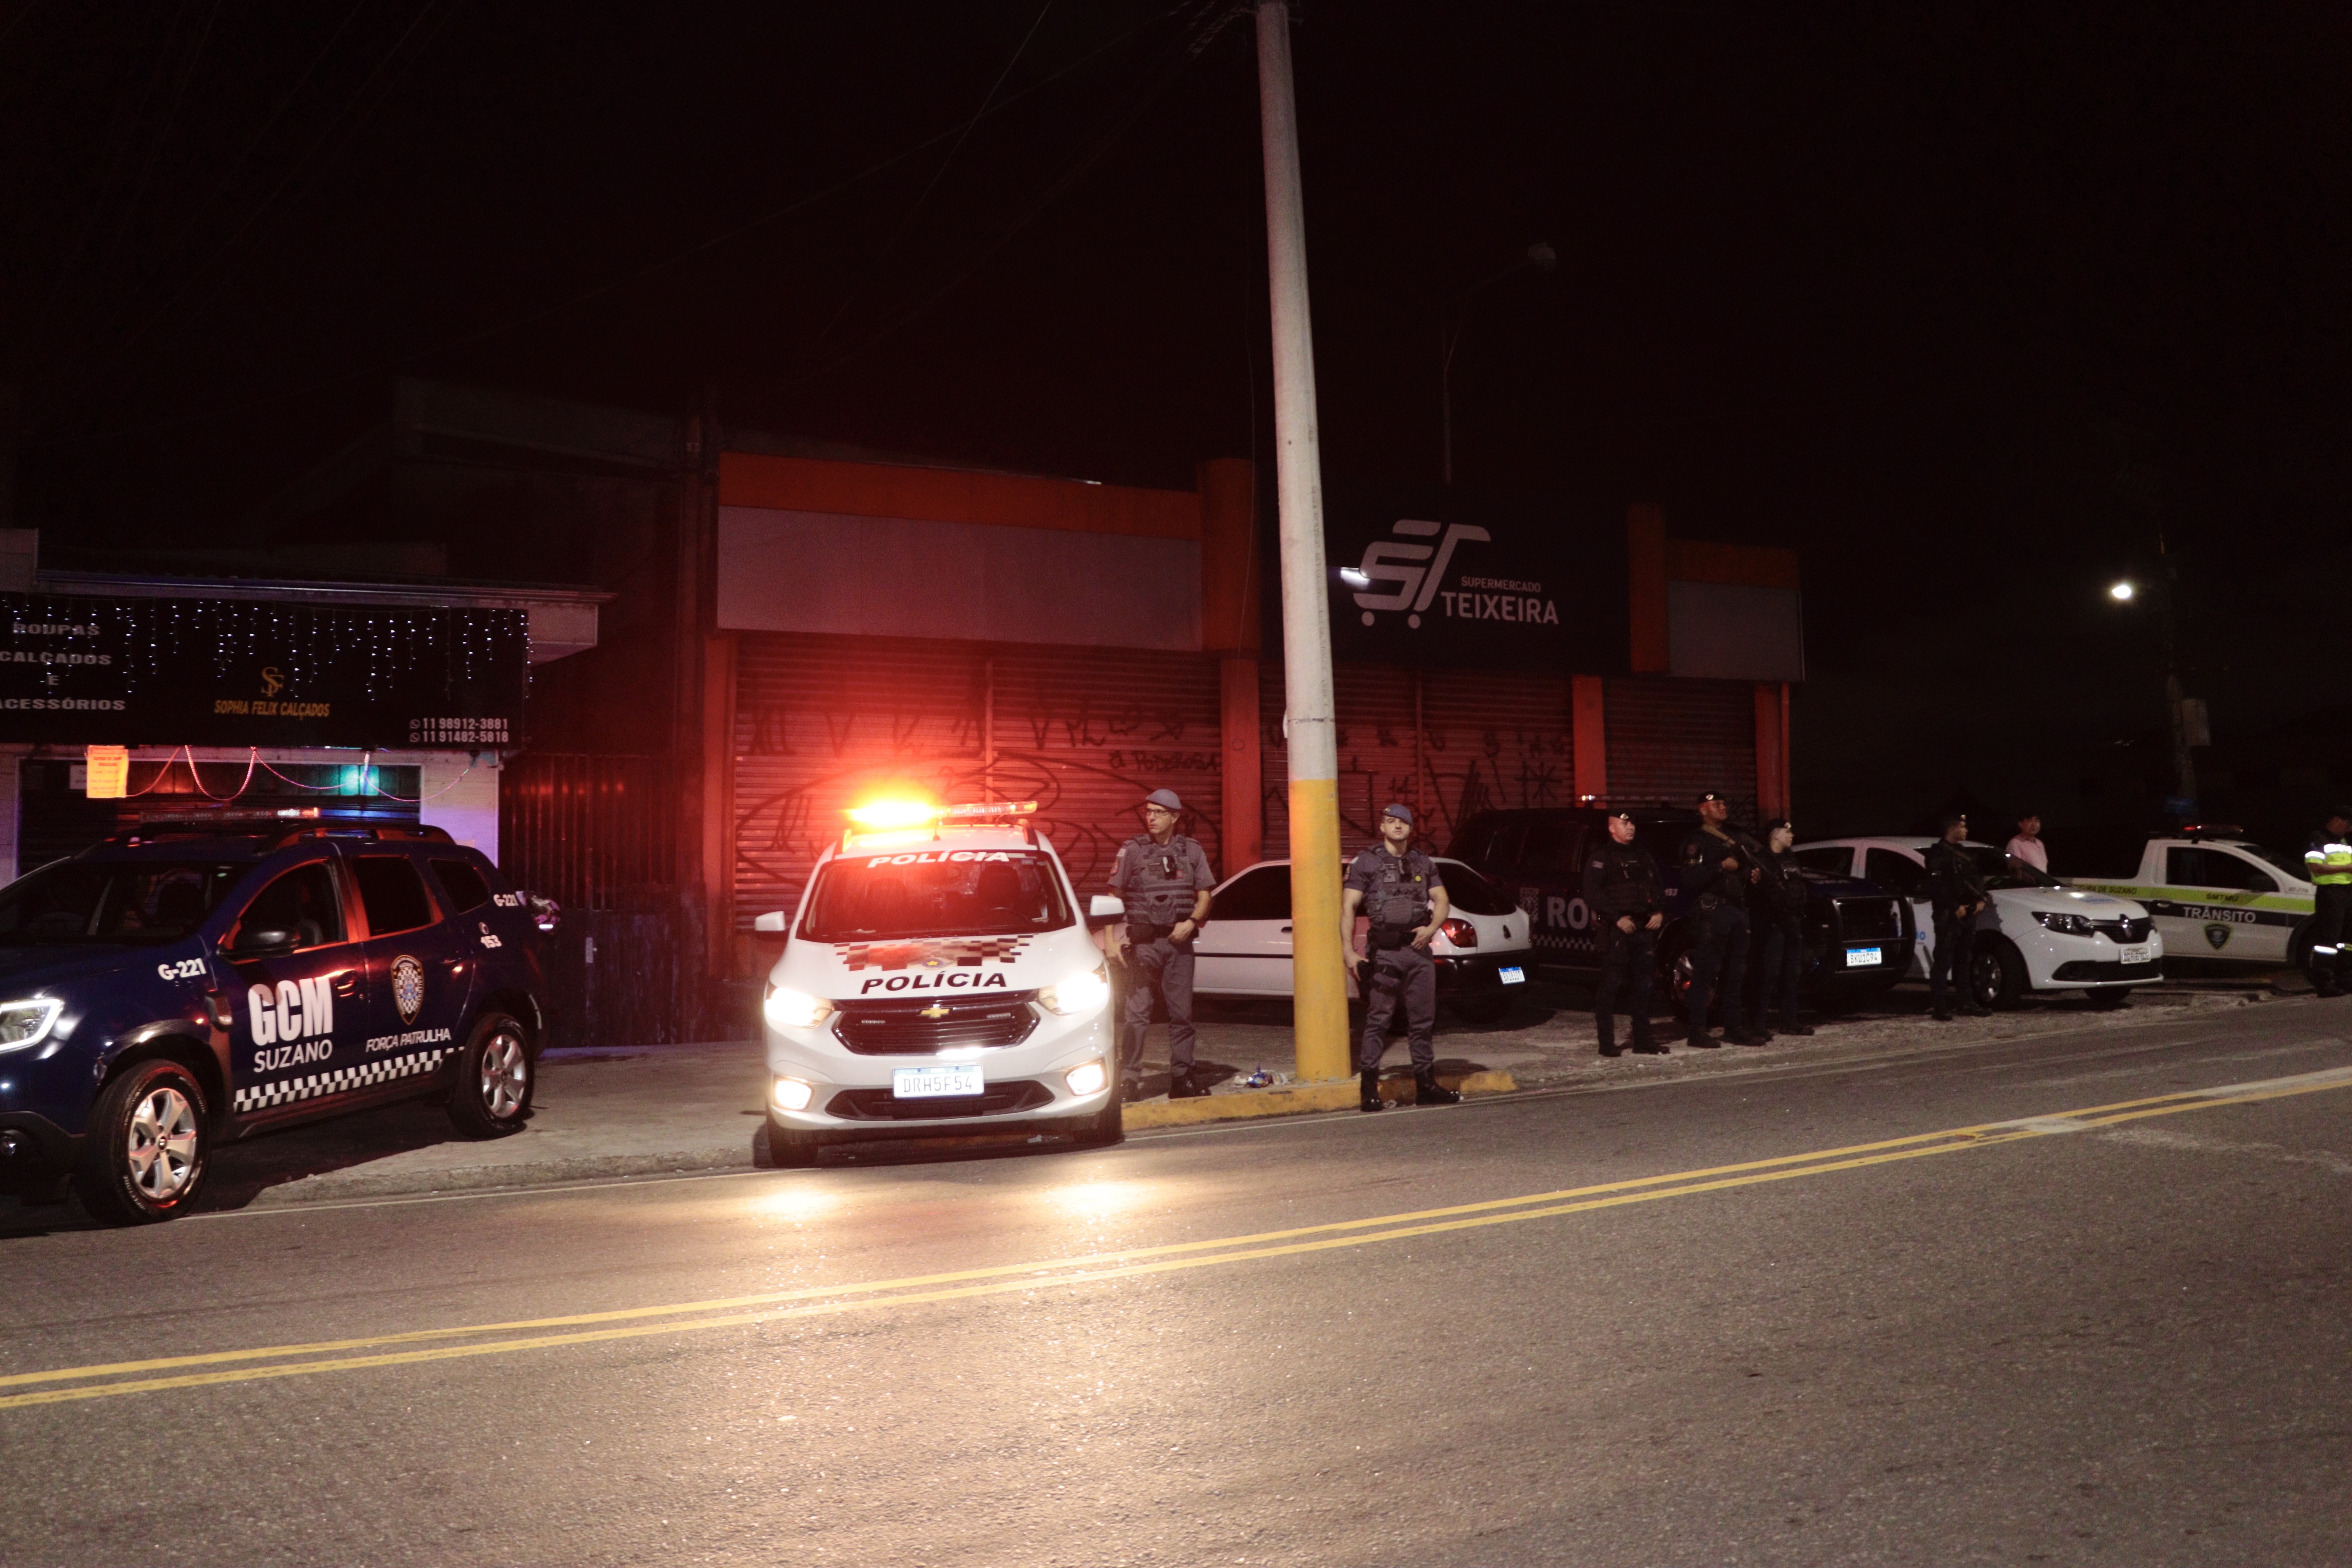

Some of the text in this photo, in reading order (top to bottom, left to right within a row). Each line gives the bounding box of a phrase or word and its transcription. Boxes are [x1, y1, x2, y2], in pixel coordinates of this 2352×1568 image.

[1461, 576, 1541, 592] SUPERMERCADO
[1441, 591, 1559, 624] TEIXEIRA
[13, 623, 101, 635] ROUPAS
[0, 651, 113, 665] CALÇADOS
[47, 675, 59, 686] E
[0, 697, 126, 710] CESSÓRIOS
[214, 699, 332, 720] SOPHIA FELIX CALÇADOS
[423, 717, 508, 730] 11 98912-3881
[423, 731, 509, 742] 11 91482-5818
[867, 850, 1010, 868] POLÍCIA
[1664, 888, 1679, 897] 153
[2183, 906, 2256, 923] TRÂNSITO
[480, 935, 502, 948] 153
[158, 958, 207, 980] G-221
[861, 971, 1006, 995] POLÍCIA
[248, 978, 333, 1046] GCM
[365, 1028, 452, 1053] FORÇA PATRULHA
[253, 1039, 333, 1073] SUZANO
